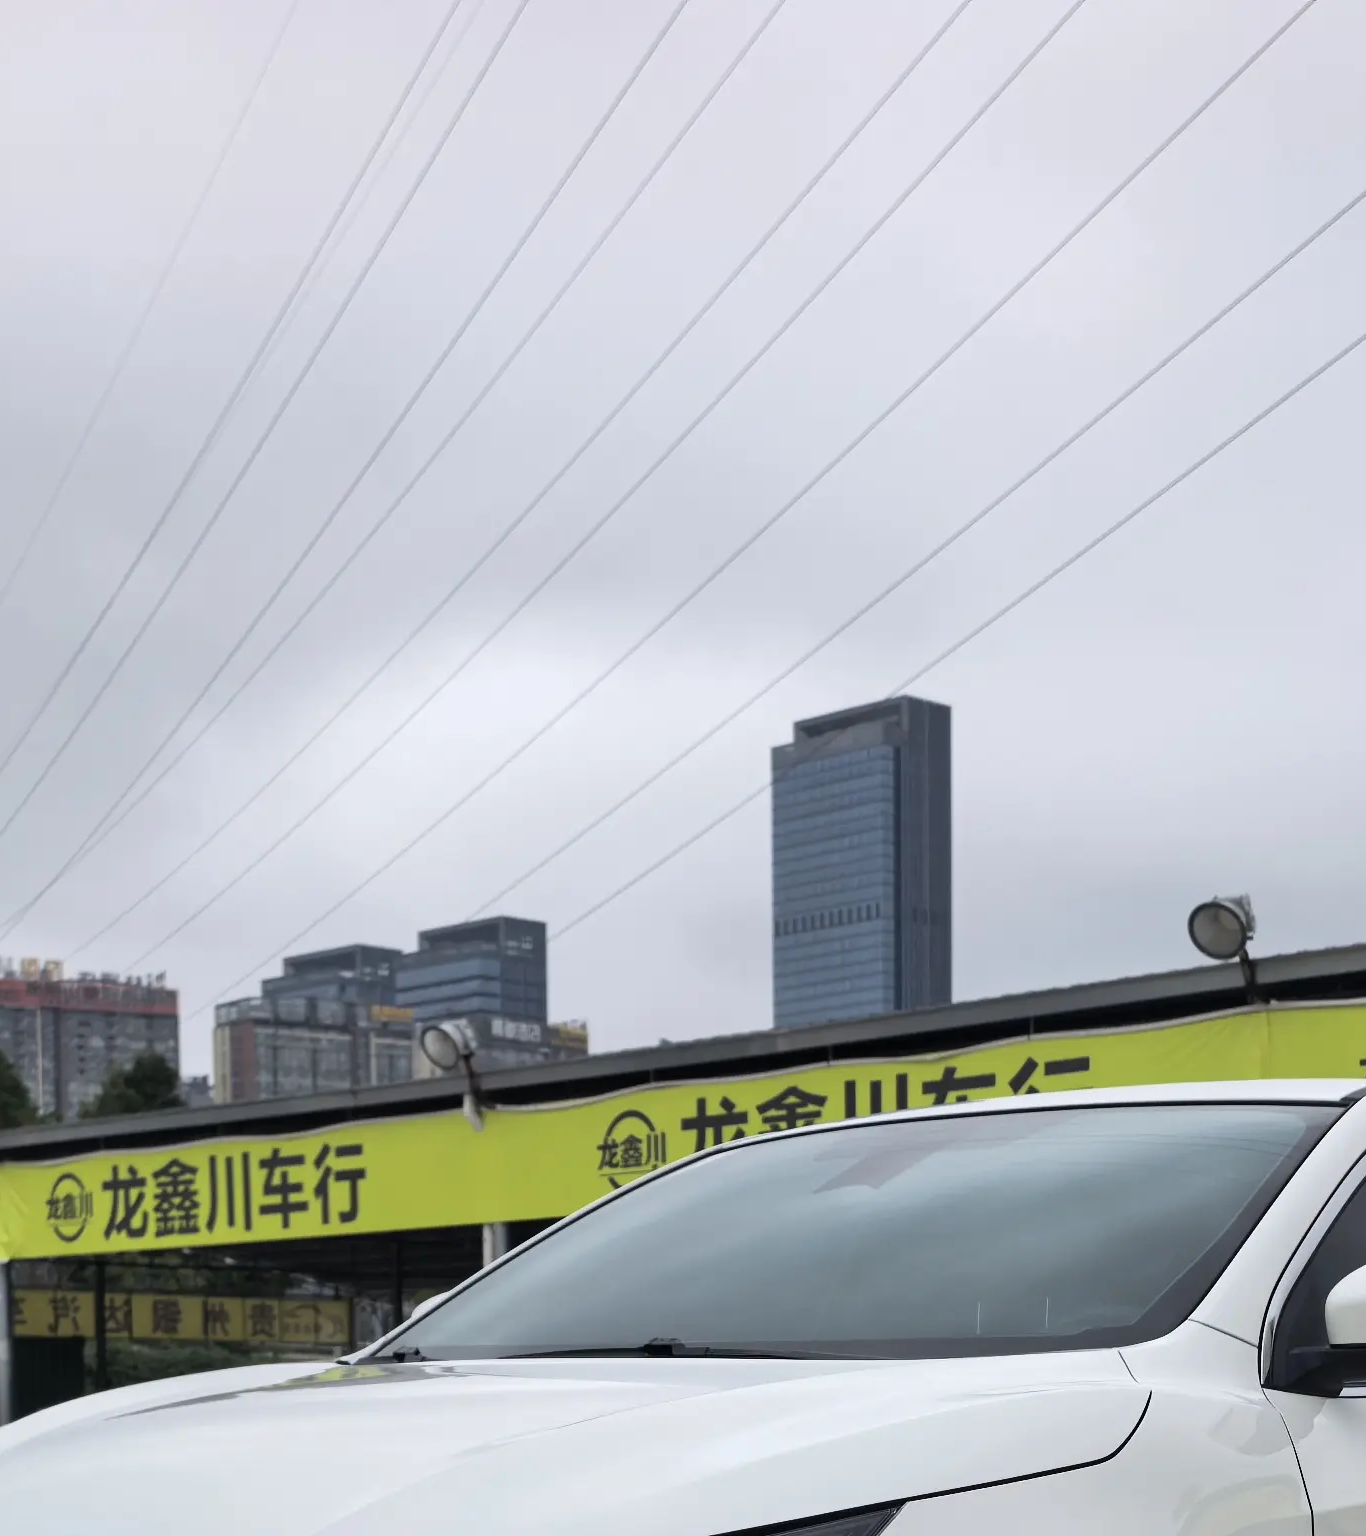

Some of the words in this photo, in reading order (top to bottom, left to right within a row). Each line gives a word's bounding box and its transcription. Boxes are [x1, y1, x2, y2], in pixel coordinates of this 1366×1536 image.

[596, 1131, 667, 1171] 龙鑫川
[46, 1192, 93, 1220] 龙鑫川
[102, 1143, 366, 1240] 龙鑫川车行
